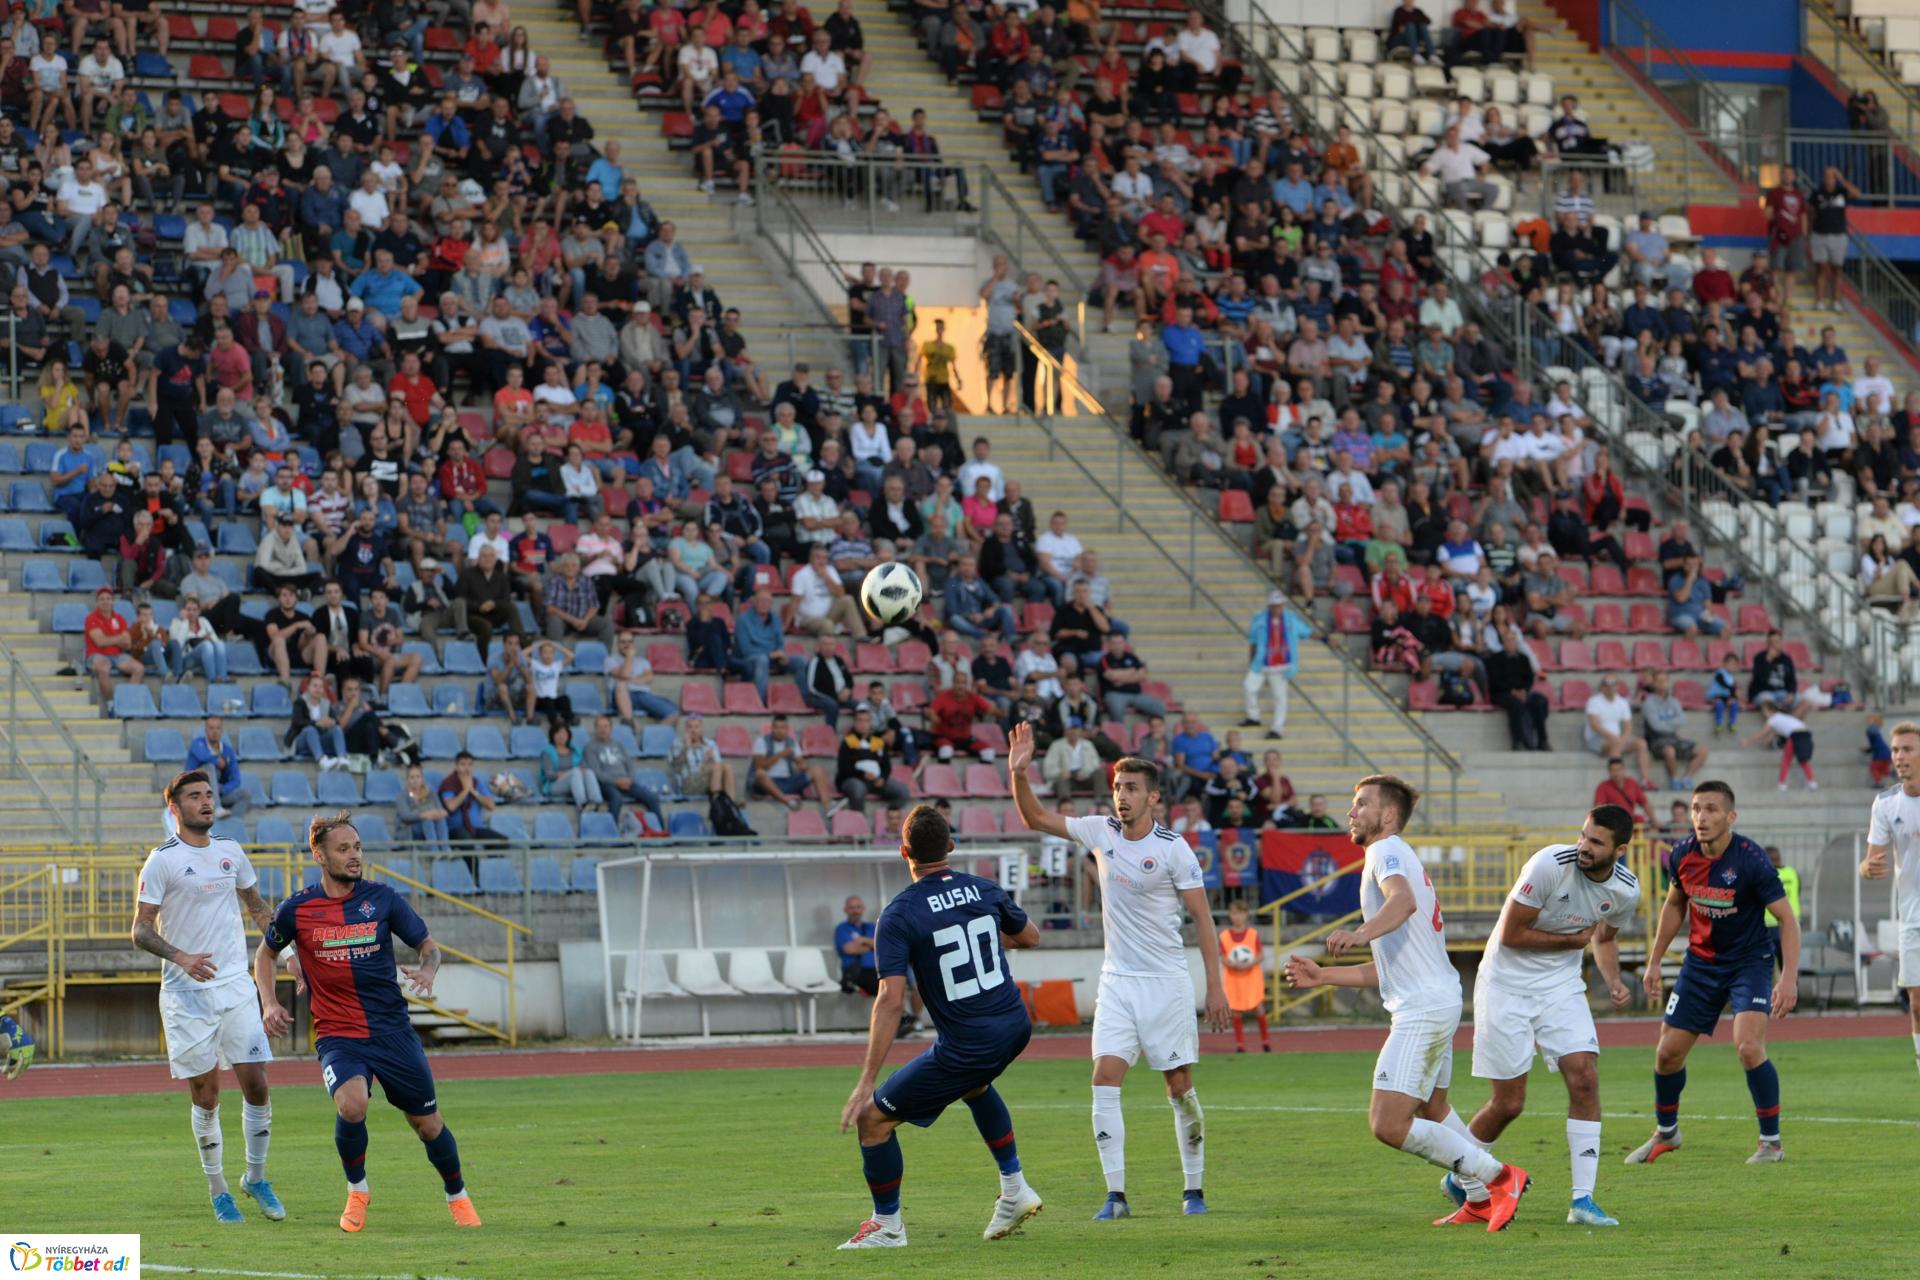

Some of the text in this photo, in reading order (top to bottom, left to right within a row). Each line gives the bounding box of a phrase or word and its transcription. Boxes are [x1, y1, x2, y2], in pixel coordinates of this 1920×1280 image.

[1008, 864, 1018, 885] E
[927, 885, 982, 913] BUSAI
[312, 921, 378, 942] REVESZ
[932, 914, 1005, 1002] 20
